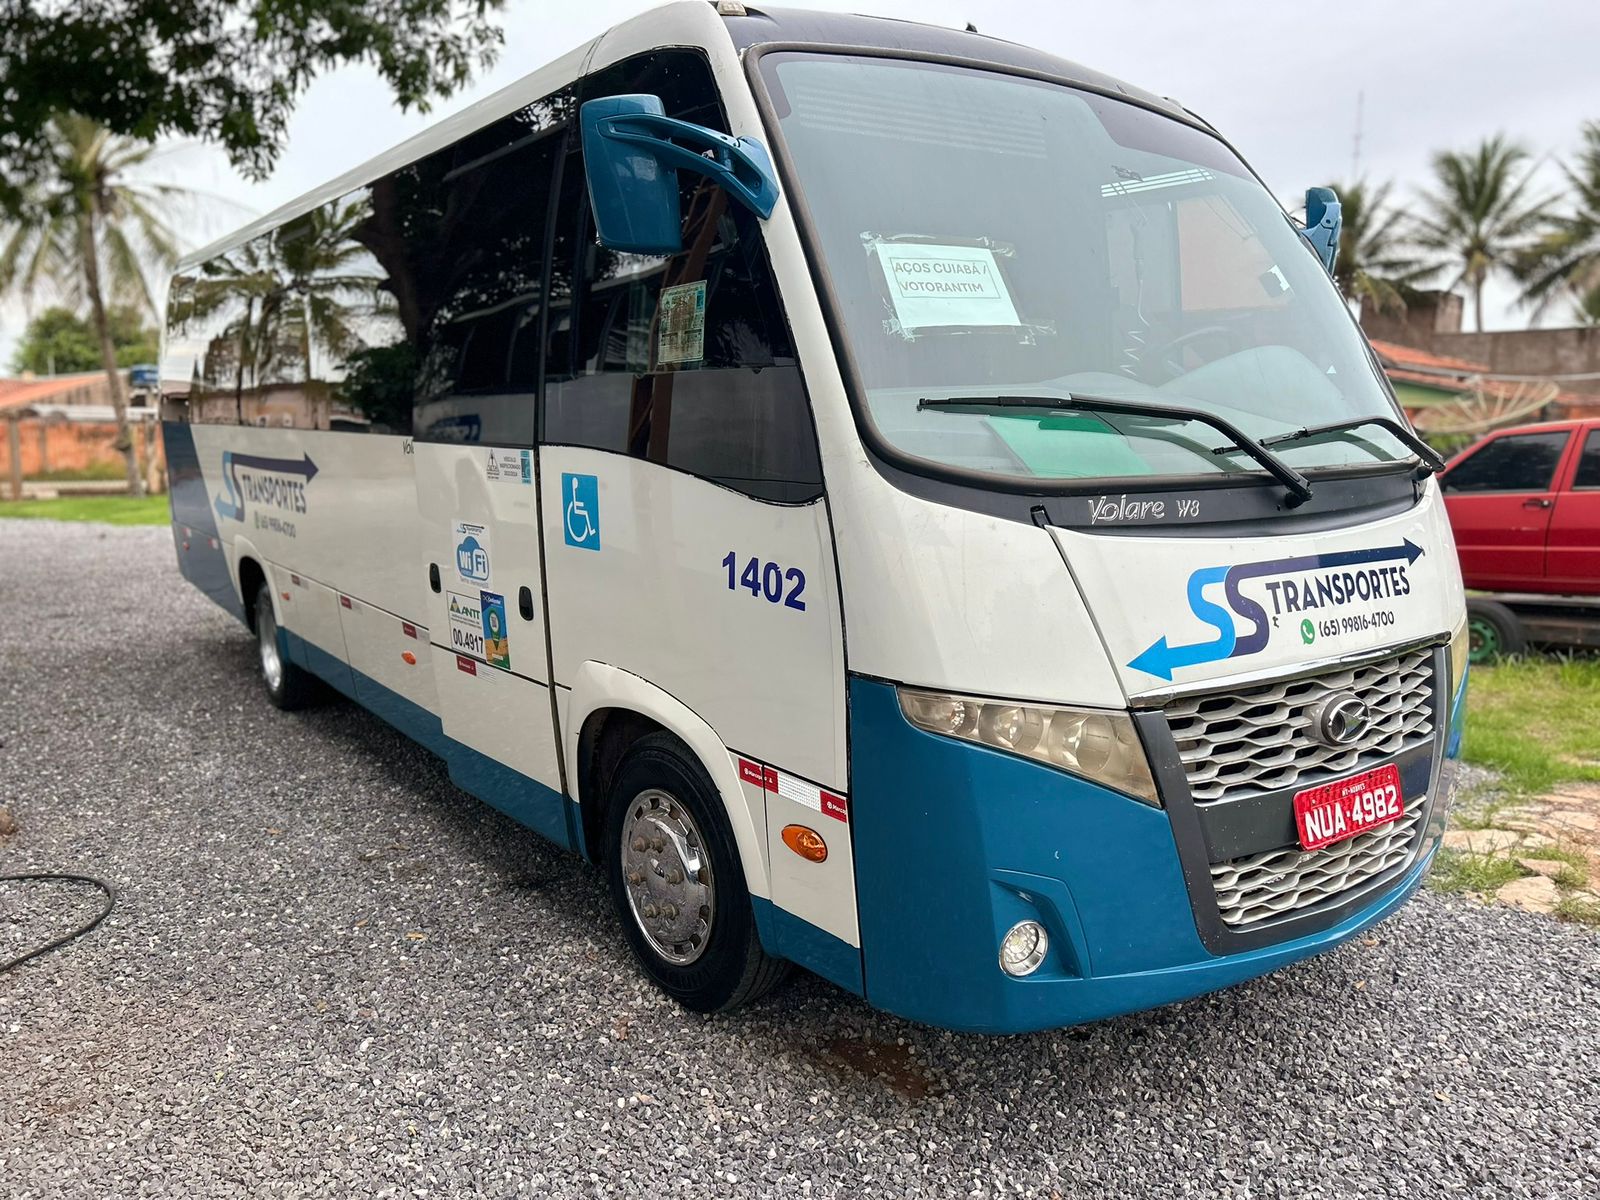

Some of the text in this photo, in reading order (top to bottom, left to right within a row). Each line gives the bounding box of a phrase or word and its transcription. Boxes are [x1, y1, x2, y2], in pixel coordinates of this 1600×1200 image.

[894, 262, 930, 275] AÇOS
[933, 262, 981, 275] CUIABÁ
[900, 281, 984, 293] VOTORANTIM
[242, 474, 306, 515] TRANSPORTES
[1088, 494, 1200, 525] Volare W8
[722, 551, 806, 612] 1402
[1265, 565, 1410, 615] TRANSPORTES
[461, 606, 481, 620] ANTT
[1319, 610, 1395, 637] (65) 99816-4700
[452, 627, 484, 654] 00.4917
